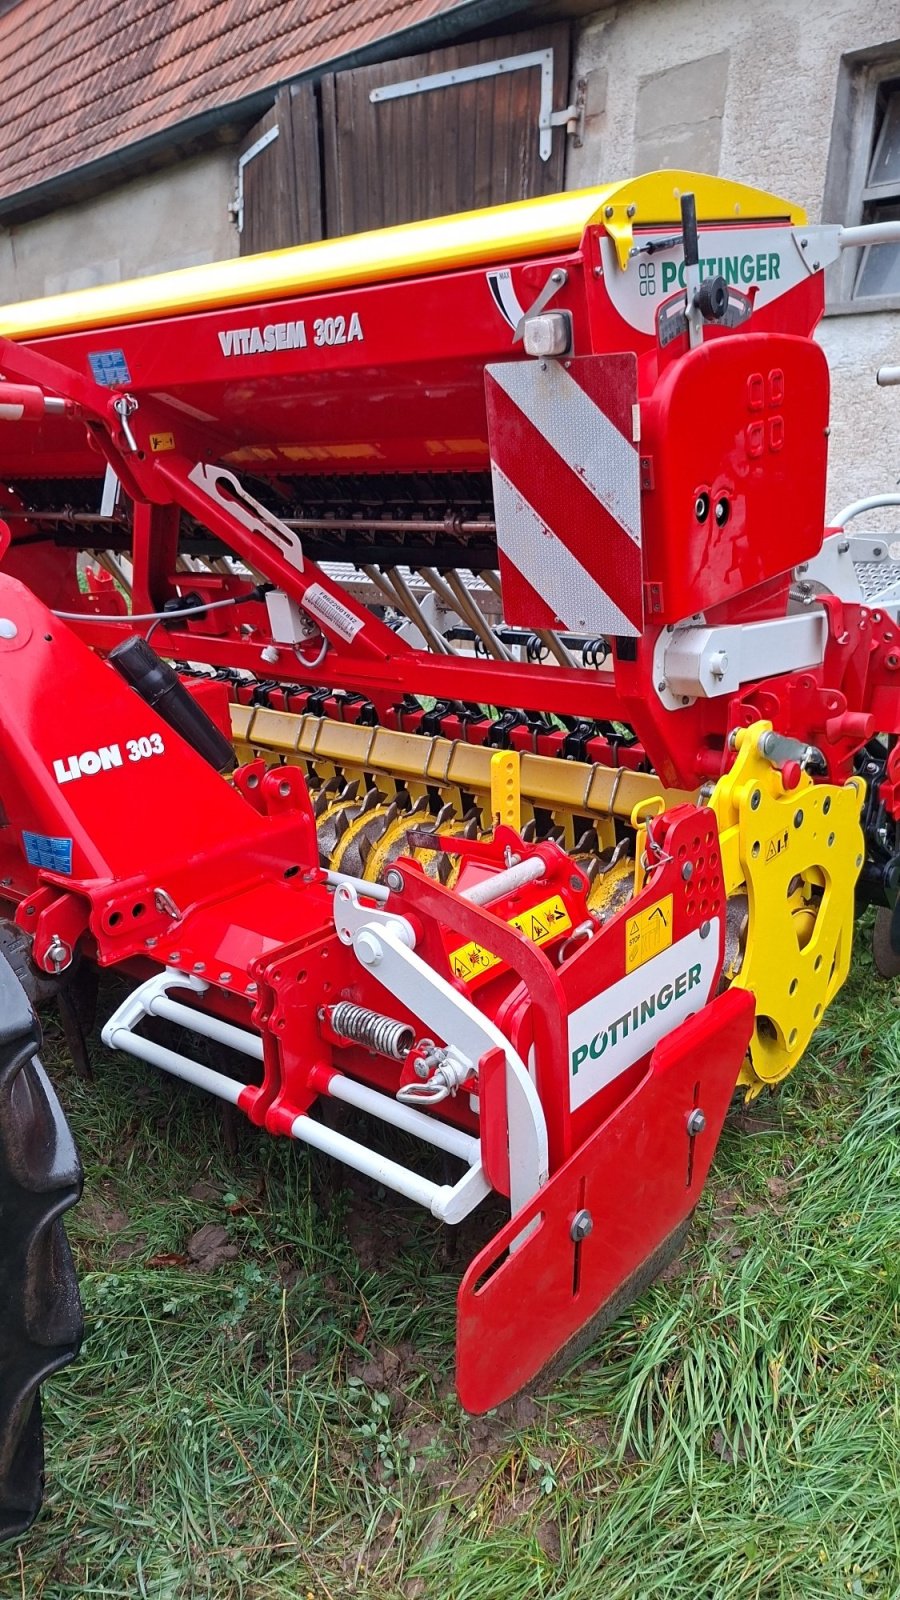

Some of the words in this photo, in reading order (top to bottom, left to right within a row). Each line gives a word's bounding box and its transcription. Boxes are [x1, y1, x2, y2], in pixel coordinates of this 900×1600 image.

[218, 321, 307, 357] VITASEM
[53, 744, 123, 784] LION
[126, 733, 165, 762] 303
[628, 934, 641, 947] STOP
[572, 963, 702, 1076] PÖTTINGER
